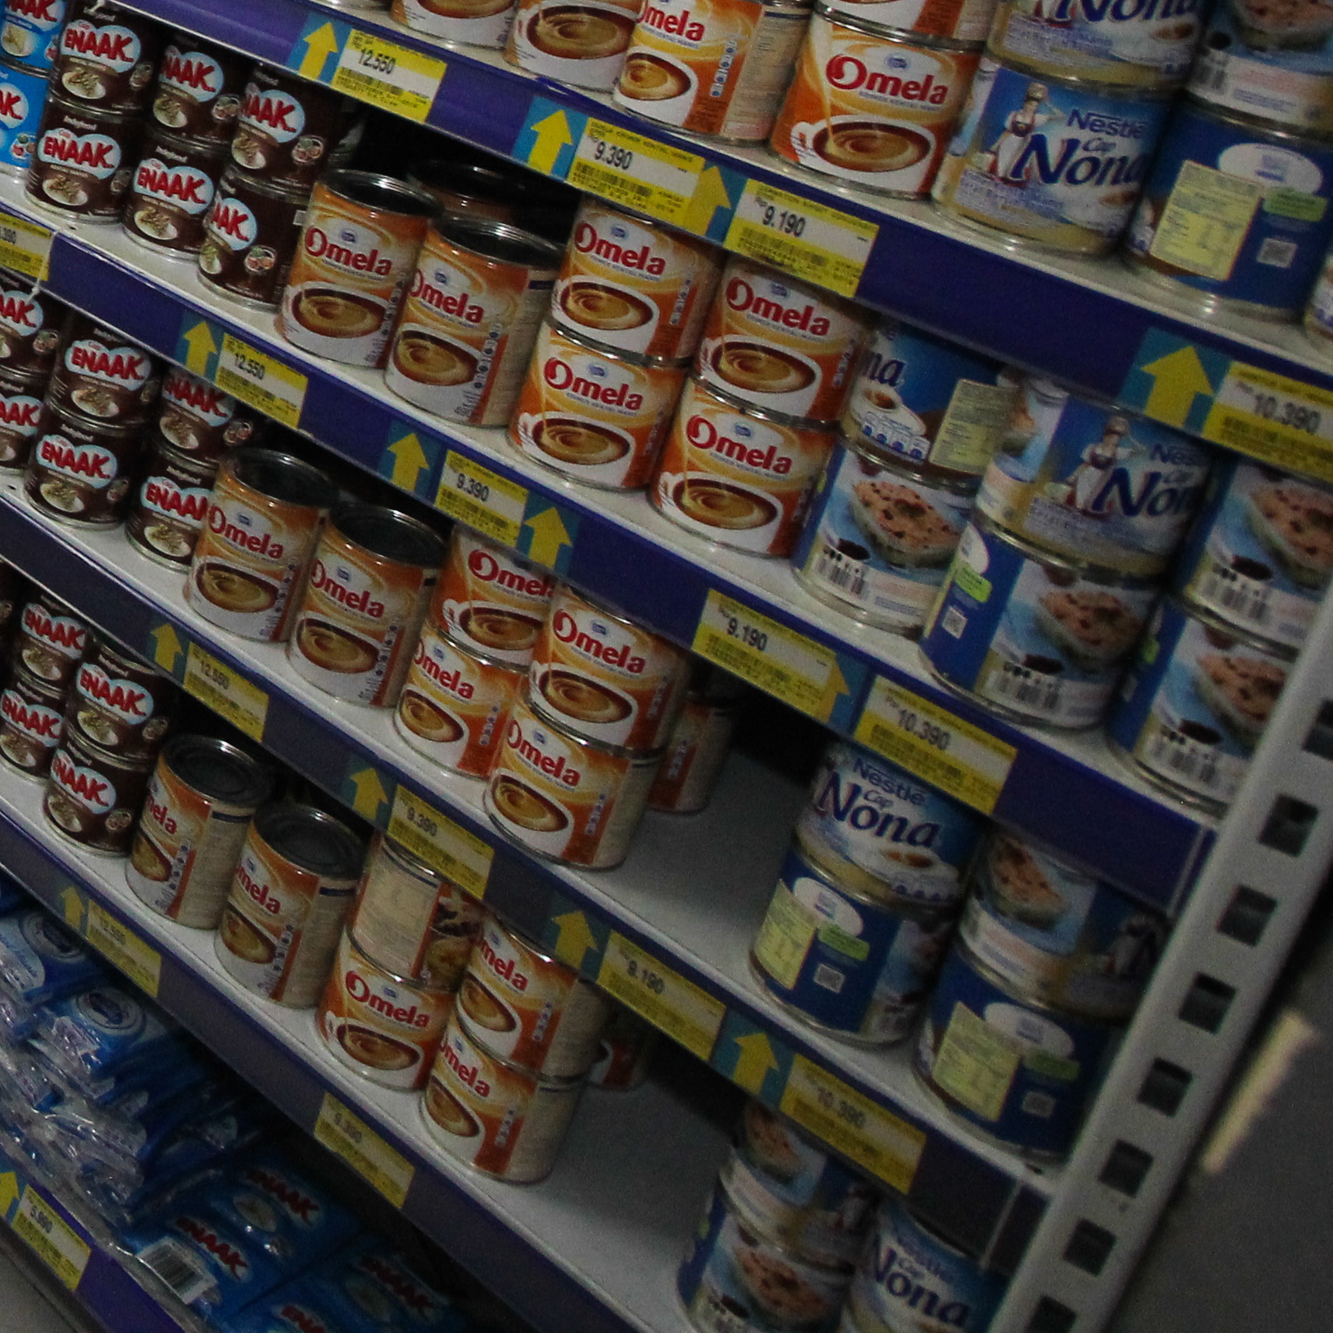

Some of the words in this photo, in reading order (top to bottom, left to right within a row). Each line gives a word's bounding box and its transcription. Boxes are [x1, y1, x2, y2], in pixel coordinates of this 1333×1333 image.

[63, 27, 135, 61] ENAAK
[357, 47, 397, 74] 12.550
[825, 54, 948, 106] Omela
[43, 134, 116, 168] ENAAK
[594, 143, 633, 171] 9.390
[134, 167, 208, 203] ENAAK
[762, 207, 806, 237] 9.190
[305, 226, 392, 277] Omela
[574, 223, 666, 274] Omela
[726, 276, 831, 336] Omela
[234, 350, 266, 380] 12.550
[543, 356, 644, 411] Omela
[687, 413, 794, 476] Omela
[457, 473, 489, 502] 9.390
[208, 505, 285, 560] Omela
[311, 558, 385, 619] Omela
[552, 607, 646, 675] Omela
[726, 617, 766, 652] 9.190
[346, 971, 431, 1030] Omela
